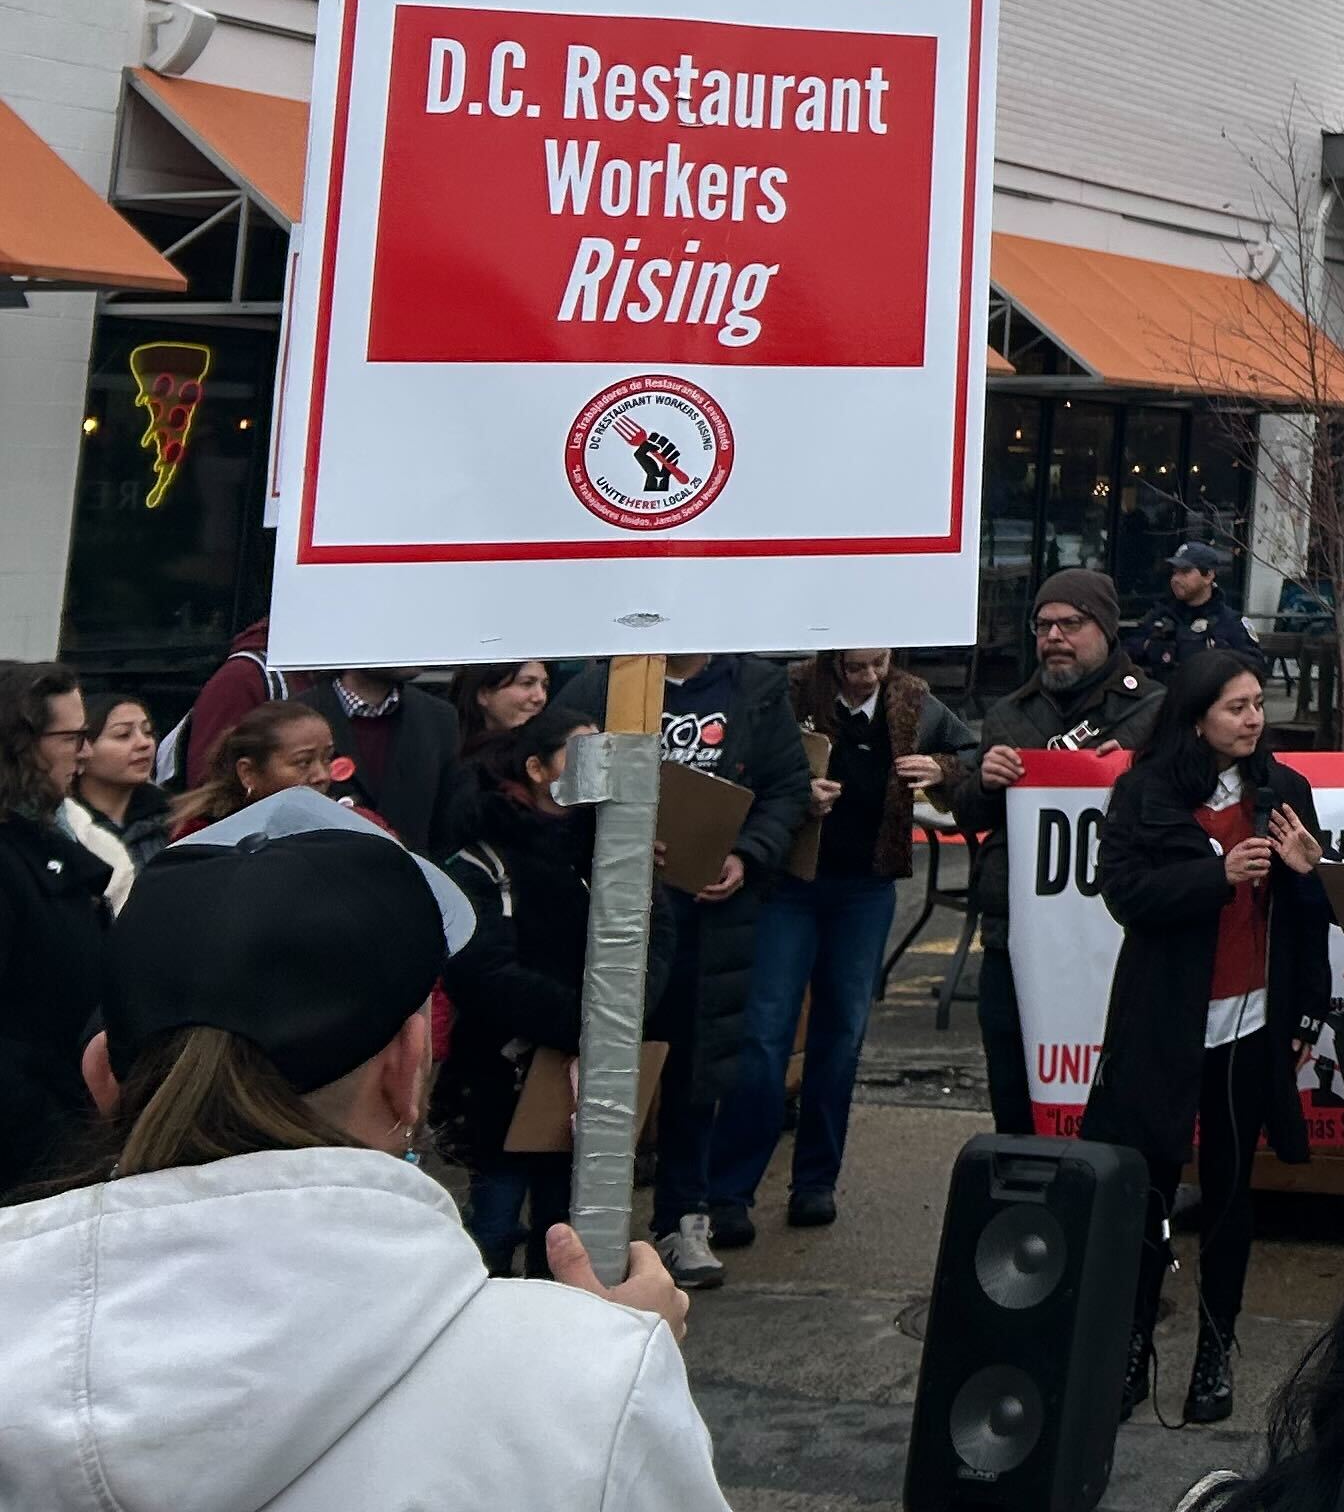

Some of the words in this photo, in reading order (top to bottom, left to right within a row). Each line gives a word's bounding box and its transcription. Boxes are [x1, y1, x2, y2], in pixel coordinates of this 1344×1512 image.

[425, 38, 541, 120] D.C.
[563, 43, 890, 136] Restaurant
[544, 138, 789, 224] Workers
[556, 236, 780, 348] Rising
[588, 435, 601, 451] DC
[595, 395, 652, 436] RESTAURANT
[654, 394, 700, 421] WORKERS
[695, 419, 713, 451] RISING
[662, 487, 694, 508] LOCAL
